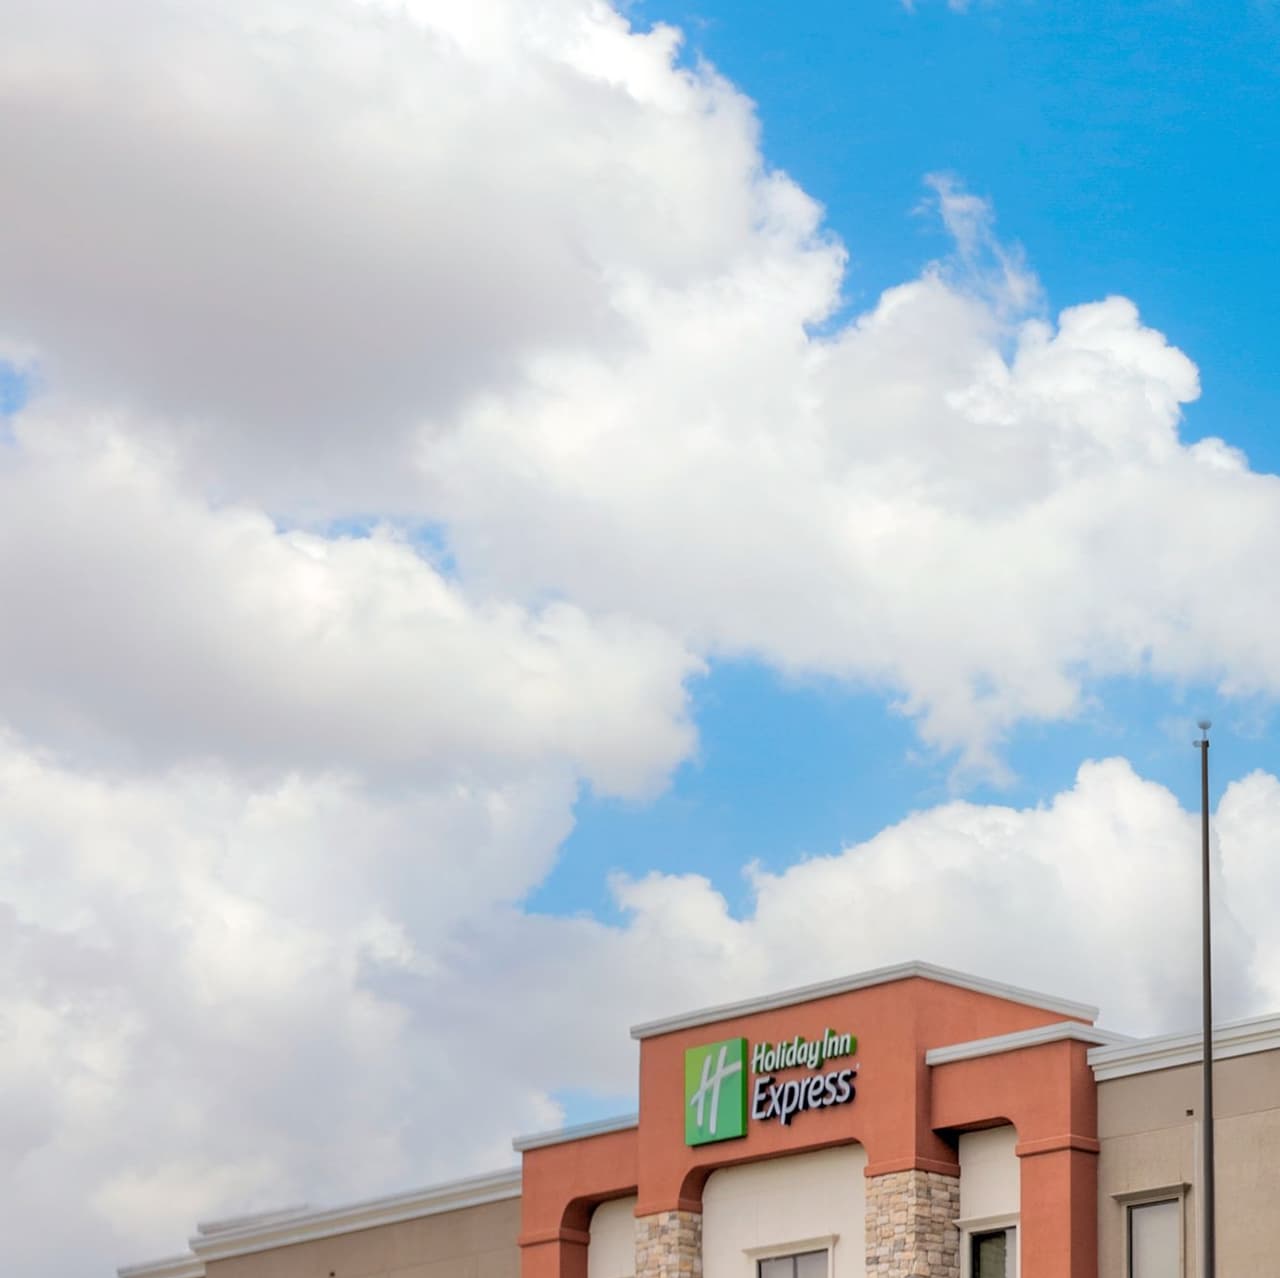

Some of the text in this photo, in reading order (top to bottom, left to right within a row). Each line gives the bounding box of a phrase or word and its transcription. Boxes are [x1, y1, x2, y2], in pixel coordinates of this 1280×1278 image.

[751, 1028, 853, 1074] Holiday Inn
[751, 1068, 853, 1126] Express
